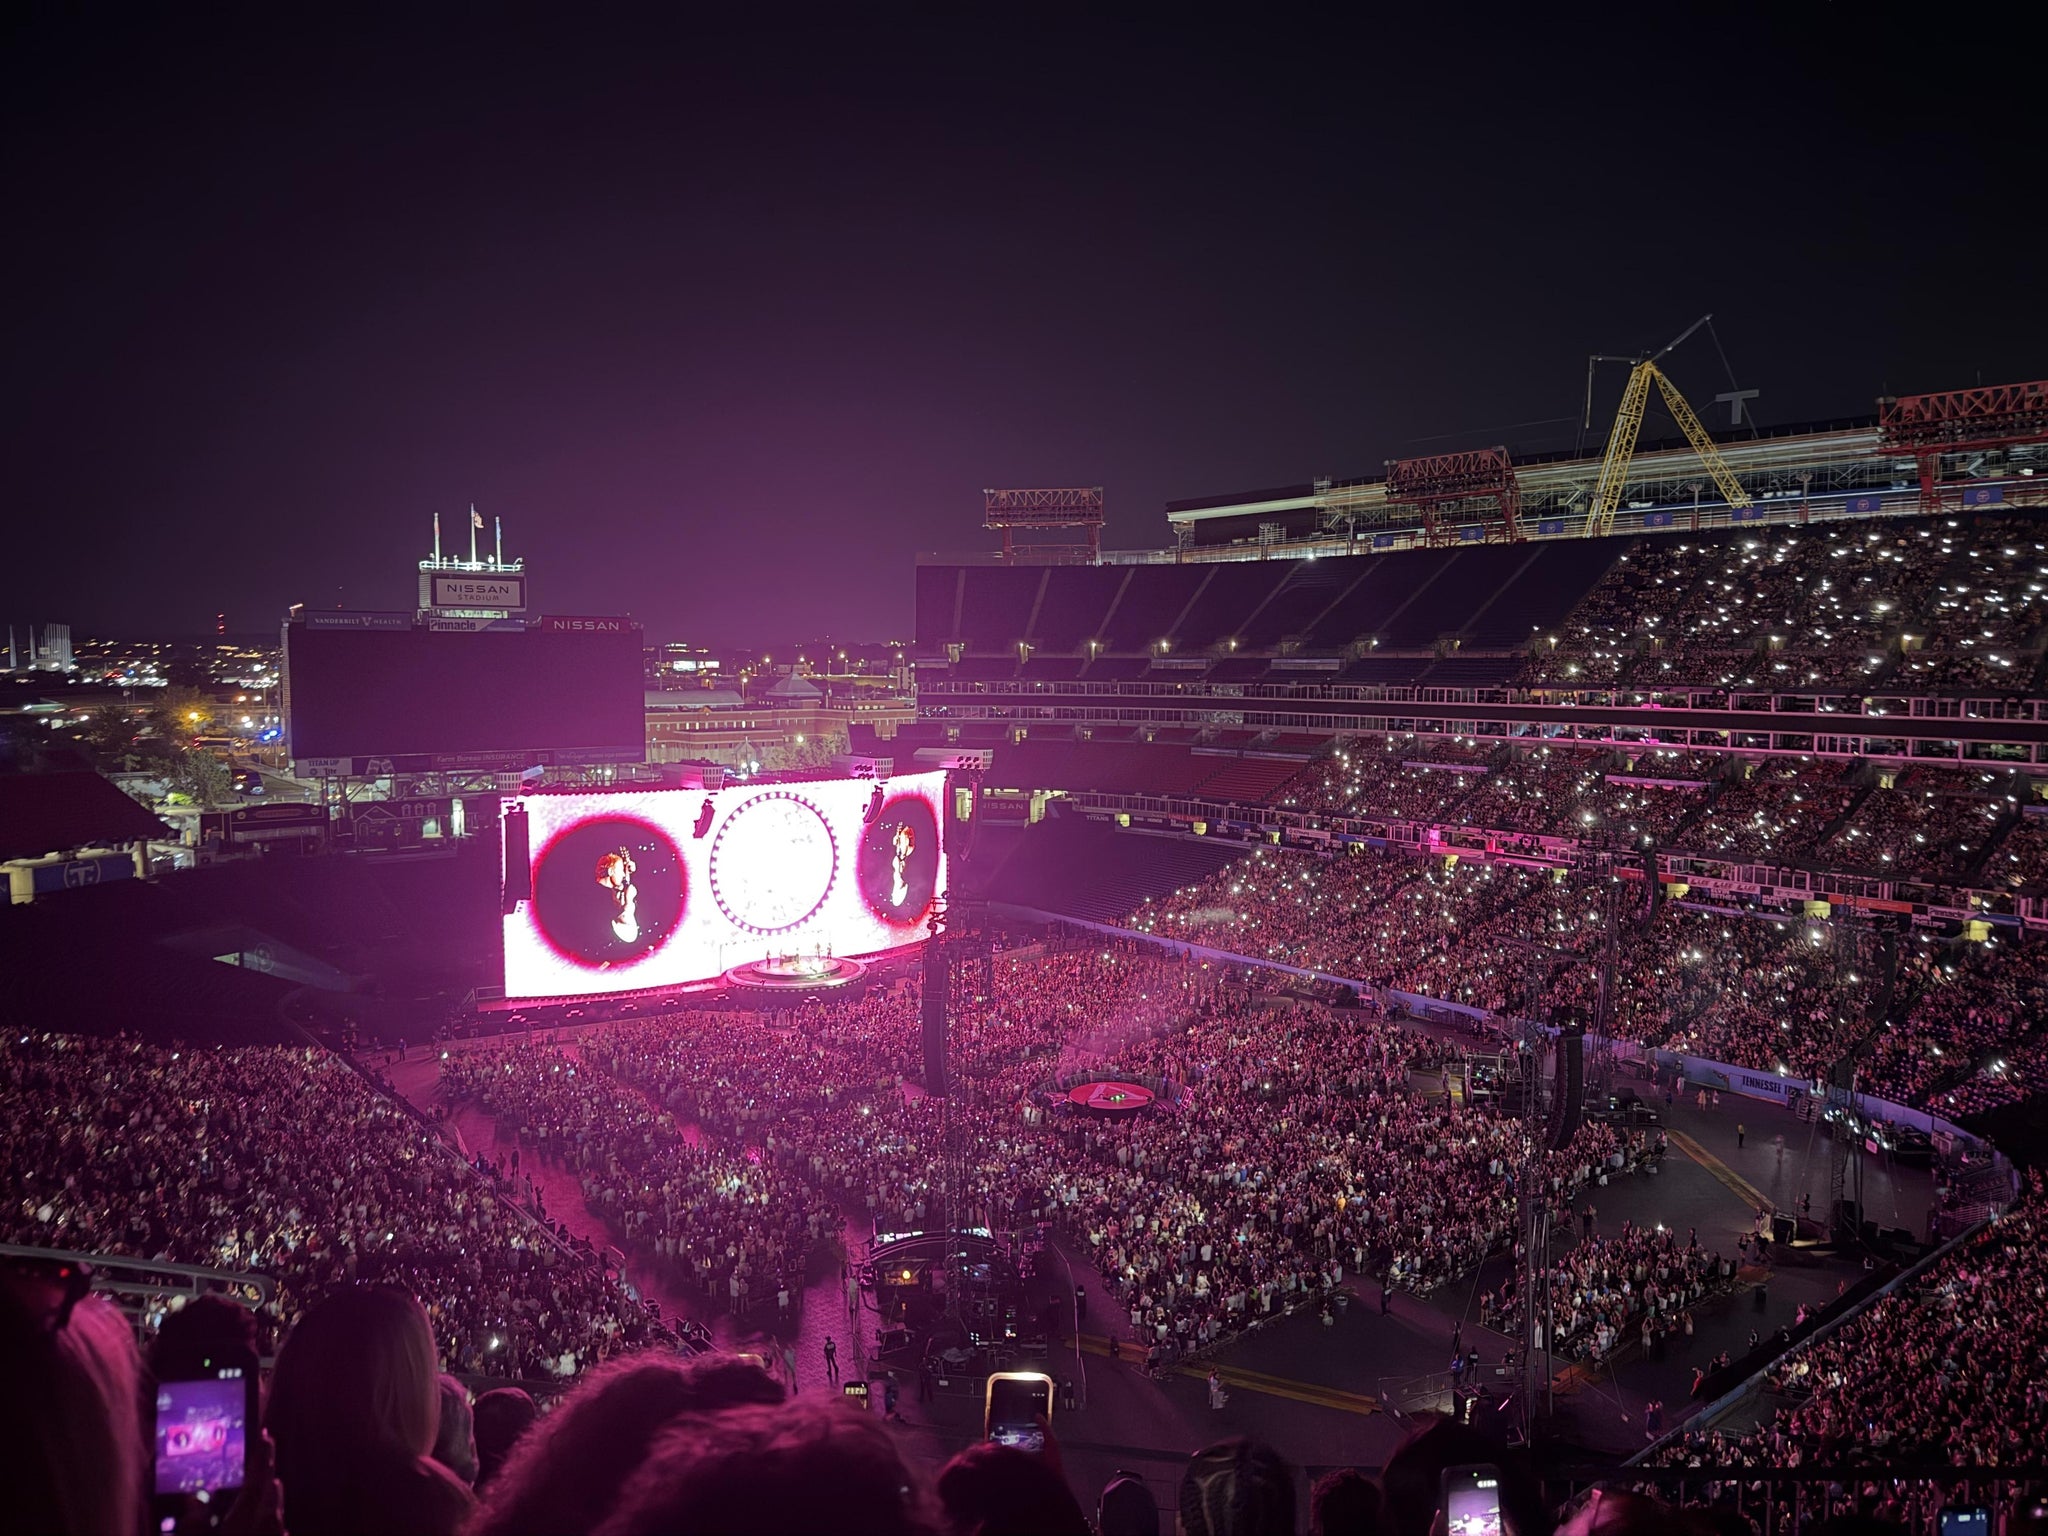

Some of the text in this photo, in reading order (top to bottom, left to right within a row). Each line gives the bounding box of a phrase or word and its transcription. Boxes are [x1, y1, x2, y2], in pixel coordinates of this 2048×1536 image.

[447, 584, 509, 594] NISSAN
[314, 617, 360, 625] VANDERBILT
[430, 619, 477, 631] Pinnacle
[554, 620, 619, 631] NISSAN
[482, 752, 526, 761] INSURANCE
[308, 759, 329, 767] TITAN
[1742, 1075, 1781, 1093] TENNESSEE
